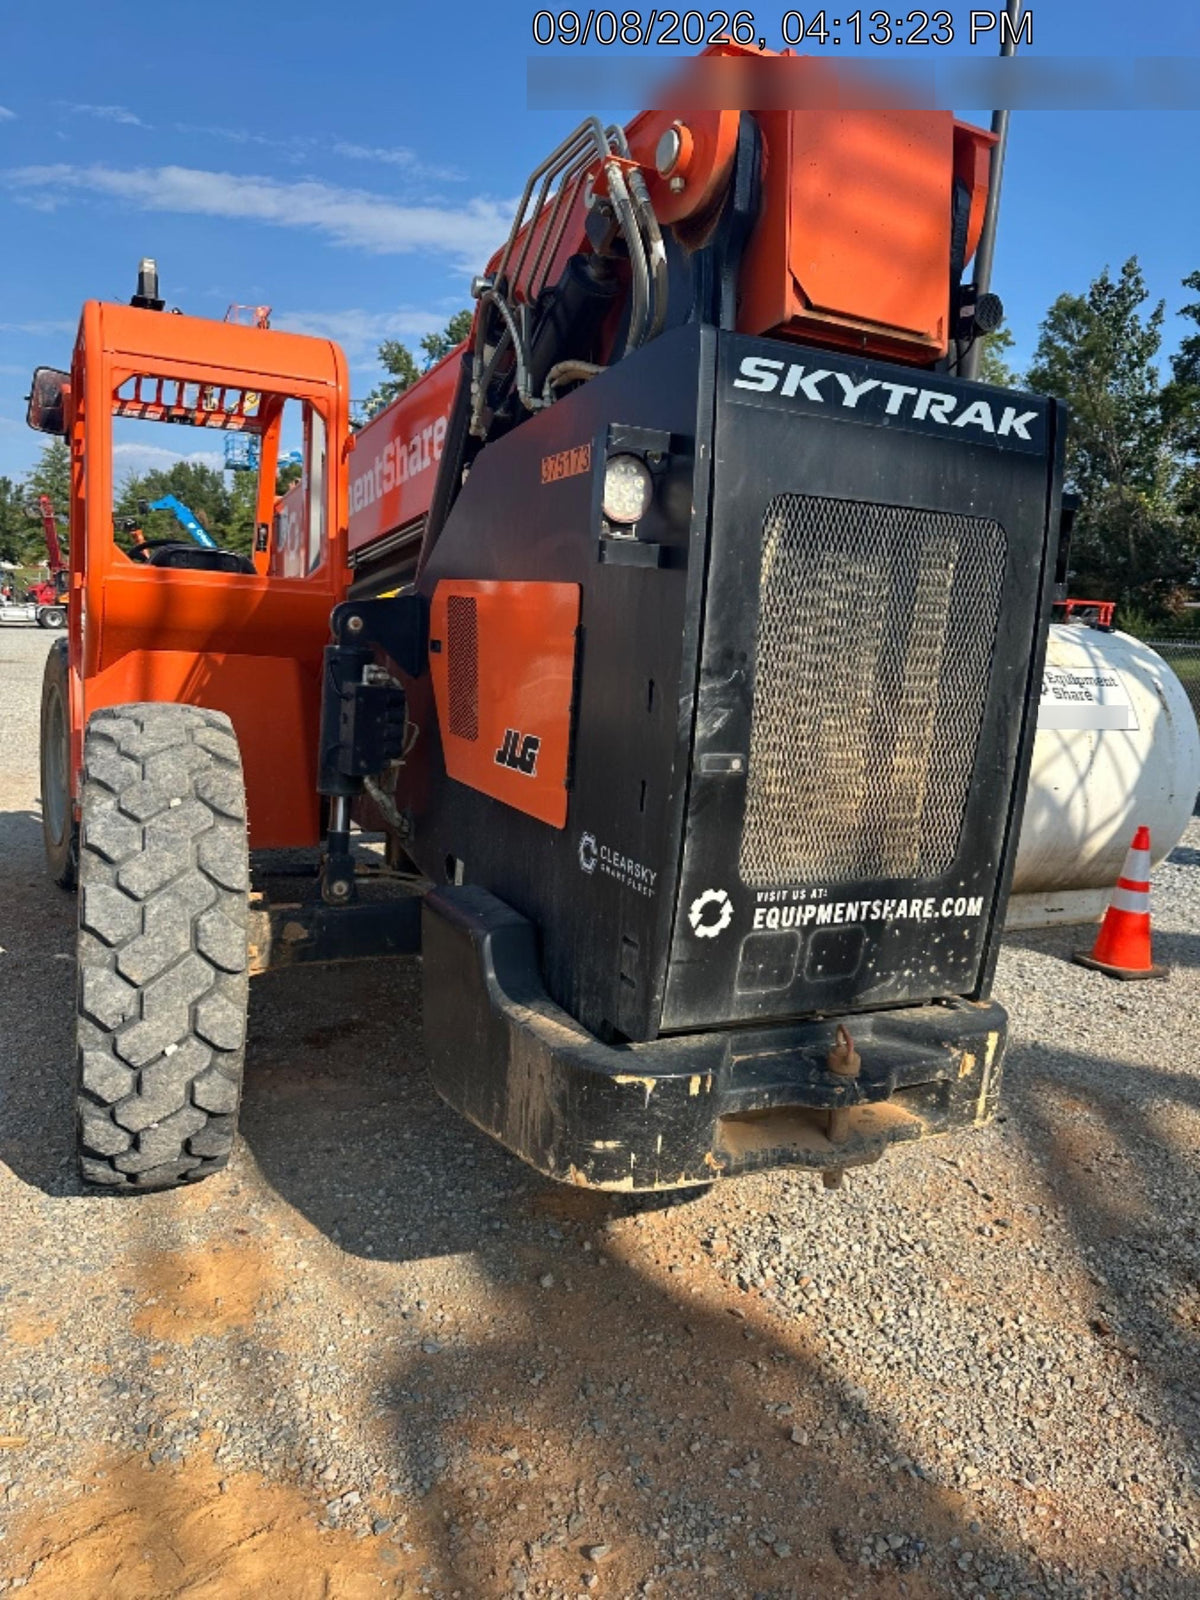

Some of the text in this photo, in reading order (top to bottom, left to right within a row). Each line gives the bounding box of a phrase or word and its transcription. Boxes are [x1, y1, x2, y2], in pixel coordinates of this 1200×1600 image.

[733, 356, 1039, 440] SKYTRAK
[1052, 687, 1093, 702] Share
[494, 728, 541, 777] JLG
[600, 845, 657, 886] CLEARSKY
[752, 897, 984, 930] EQUIPMENTSHARE.COM
[756, 888, 828, 902] VISIT US AT:
